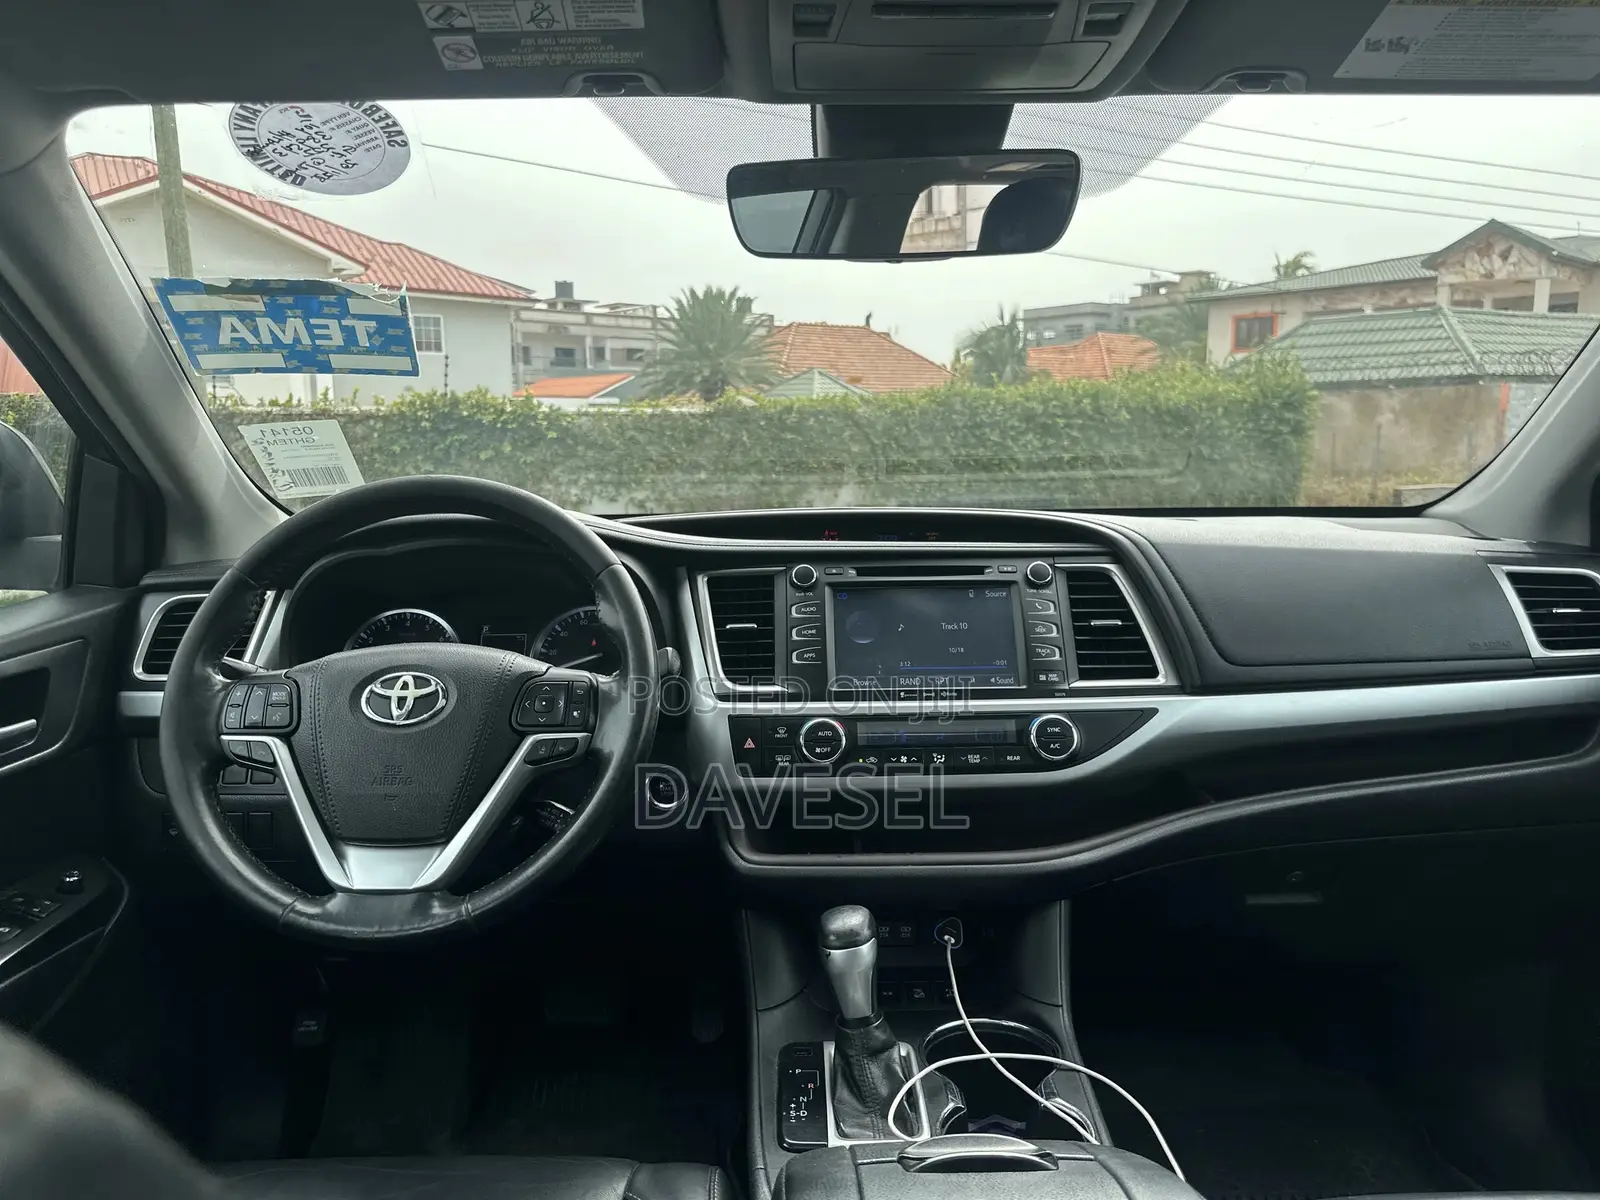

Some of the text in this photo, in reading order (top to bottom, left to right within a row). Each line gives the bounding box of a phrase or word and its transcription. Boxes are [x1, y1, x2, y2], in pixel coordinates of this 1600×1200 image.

[985, 590, 1007, 598] Source
[941, 622, 968, 630] Track 10
[853, 678, 877, 686] Browse
[383, 764, 405, 774] SRS
[371, 776, 415, 787] AIRBAG
